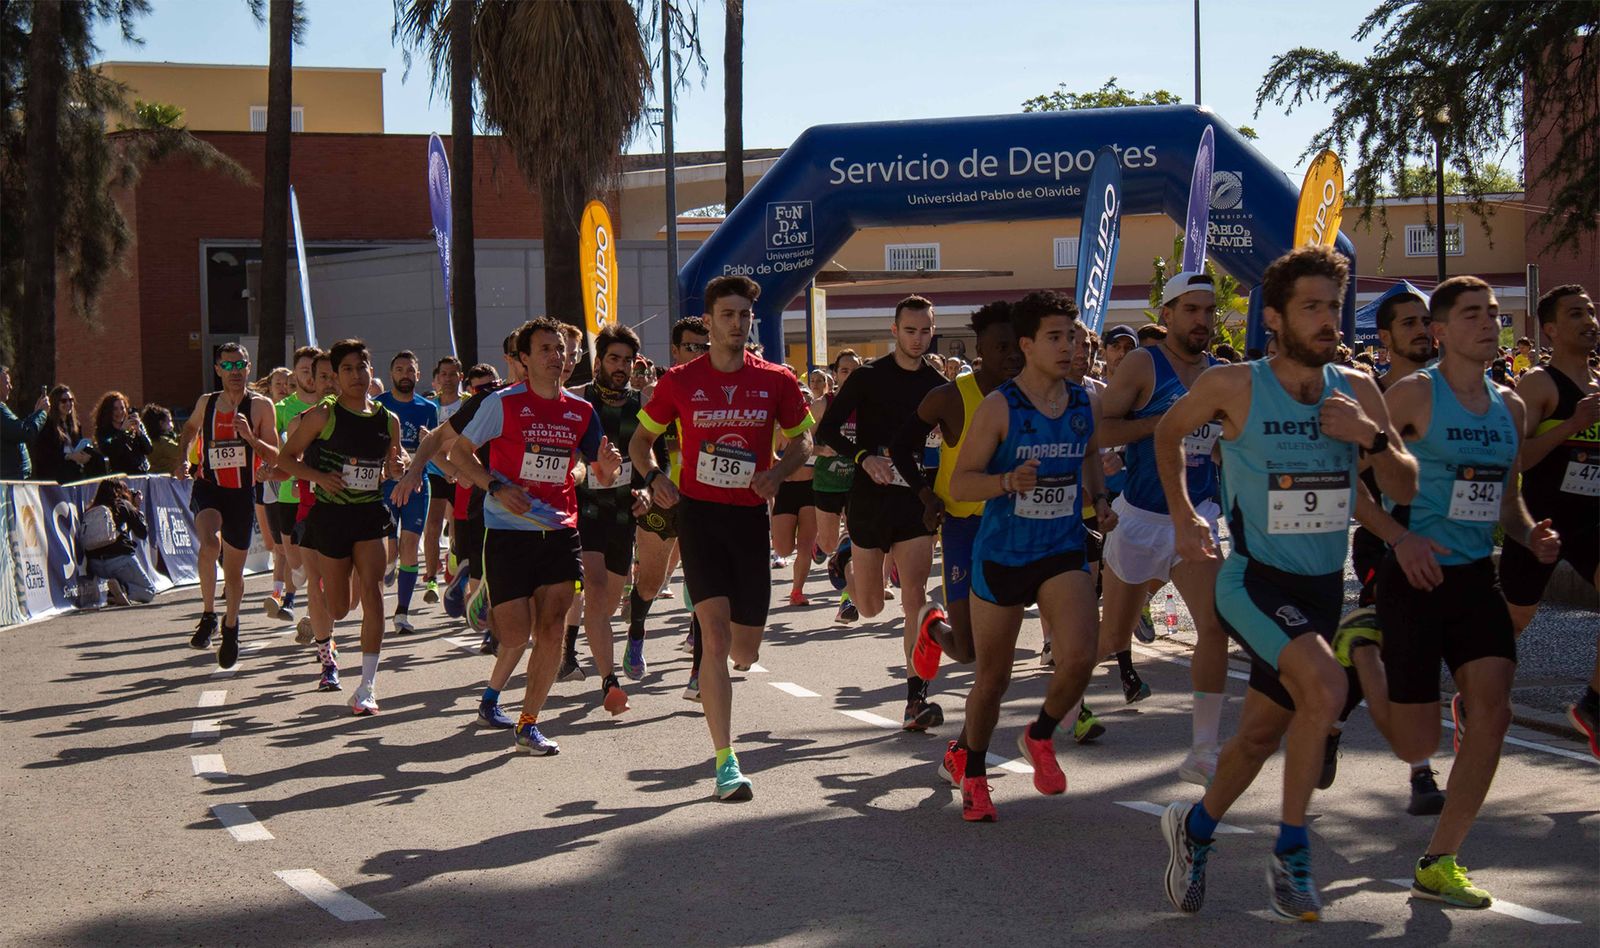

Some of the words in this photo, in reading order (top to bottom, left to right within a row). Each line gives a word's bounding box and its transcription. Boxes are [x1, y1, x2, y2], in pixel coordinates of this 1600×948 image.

[830, 153, 949, 185] Servicio
[958, 148, 999, 179] de
[1009, 143, 1158, 181] Depotes
[907, 191, 978, 205] Universidad
[981, 189, 1014, 201] Pablo
[1018, 188, 1032, 199] de
[1034, 185, 1081, 198] Olavide
[766, 248, 814, 261] Universidad
[1084, 183, 1116, 314] SDUPO
[723, 264, 754, 276] Pablo
[756, 264, 771, 274] de
[774, 258, 814, 272] Olavide
[596, 226, 608, 329] SDUPO
[1262, 416, 1322, 441] nerj
[1446, 425, 1502, 447] nerja
[215, 447, 236, 459] 163
[535, 456, 560, 470] 510
[711, 457, 741, 475] 136
[354, 467, 374, 480] 130
[1579, 465, 1600, 481] 47
[1032, 487, 1065, 504] 560
[1304, 491, 1317, 512] 9
[1468, 483, 1495, 502] 342
